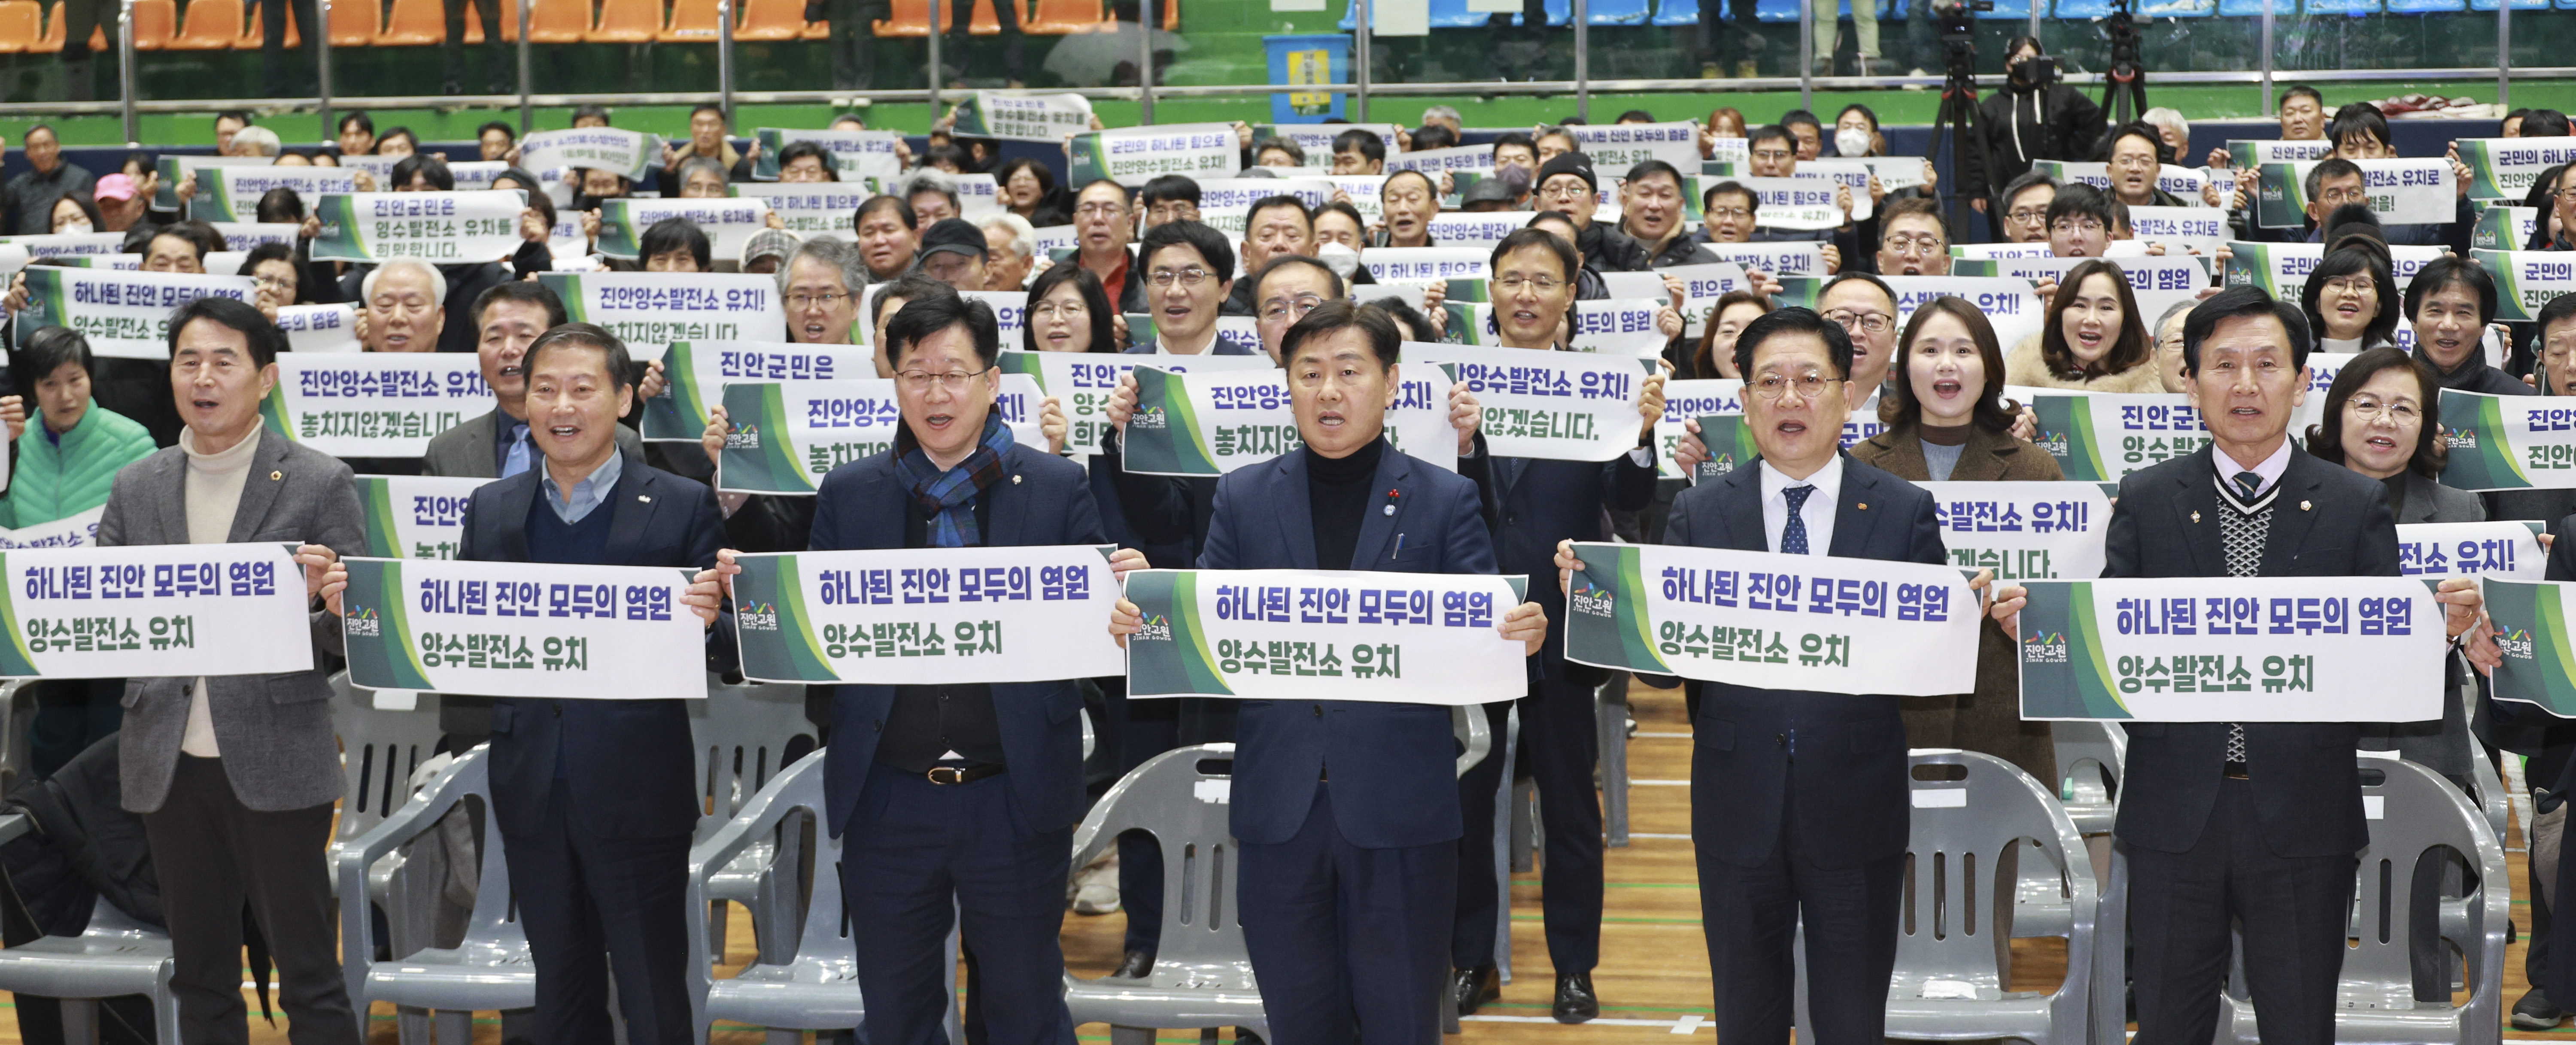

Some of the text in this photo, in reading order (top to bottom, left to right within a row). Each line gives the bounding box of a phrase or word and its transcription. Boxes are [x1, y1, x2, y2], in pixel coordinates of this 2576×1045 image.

[1112, 134, 1225, 154] 군민의 하나된 힘으로
[1611, 130, 1630, 141] 진안
[1634, 128, 1665, 141] 모두의
[1112, 154, 1226, 176] 진안양수발전소 유치!
[1444, 154, 1473, 169] 모두의
[1584, 150, 1628, 165] 수발전소
[2500, 150, 2538, 166] 군민의
[2160, 176, 2197, 192] 힘으로
[2403, 169, 2439, 185] 유치로
[375, 200, 455, 217] 진안군민은
[1794, 191, 1831, 205] 힘으로
[376, 218, 512, 238] 양수발전소 유치를
[2183, 221, 2218, 236] 유치로
[1391, 261, 1482, 279] 하나된 힘으로
[2159, 268, 2190, 290] 염원
[2526, 262, 2572, 281] 군민의
[76, 280, 121, 305] 하나된
[126, 283, 157, 307] 진안
[601, 287, 766, 312] 진안양수발전소 유치!
[1978, 292, 2019, 315] 유치!
[1621, 310, 1651, 333] 염원
[721, 351, 834, 380] 진안군민은
[301, 370, 440, 398] 진안양수발전소
[1580, 371, 1630, 401] 유치!
[1132, 413, 1166, 425] 진안고원
[2528, 409, 2576, 431] 진안
[1702, 462, 1733, 472] 진안고원
[2032, 501, 2087, 533] 유치!
[2458, 539, 2515, 574] 유치!
[26, 560, 275, 599] 하나된 진안 모두의 염원
[819, 565, 1090, 605] 하나된 진안 모두의 염원
[421, 578, 671, 622] 하나된 진안 모두의 염원
[1573, 595, 1612, 613] 진안고원
[1662, 566, 1949, 622] 하나된 진안 모두의 염원
[1216, 585, 1493, 628] 하나된 진안 모두의 염원
[2116, 597, 2412, 636] 하나된 진안 모두의 염원
[346, 618, 379, 632] 진안고원
[740, 613, 777, 627] 진안고원
[27, 614, 194, 653] 양수발전소 유치
[823, 620, 1002, 659] 양수발전소 유치
[1659, 621, 1850, 668] 양수발전소 유치
[421, 632, 587, 671] 양수발전소 유치
[1218, 639, 1401, 680] 양수발전소 유치
[2025, 644, 2066, 658] 진안고원
[2117, 655, 2313, 694] 양수발전소 유치
